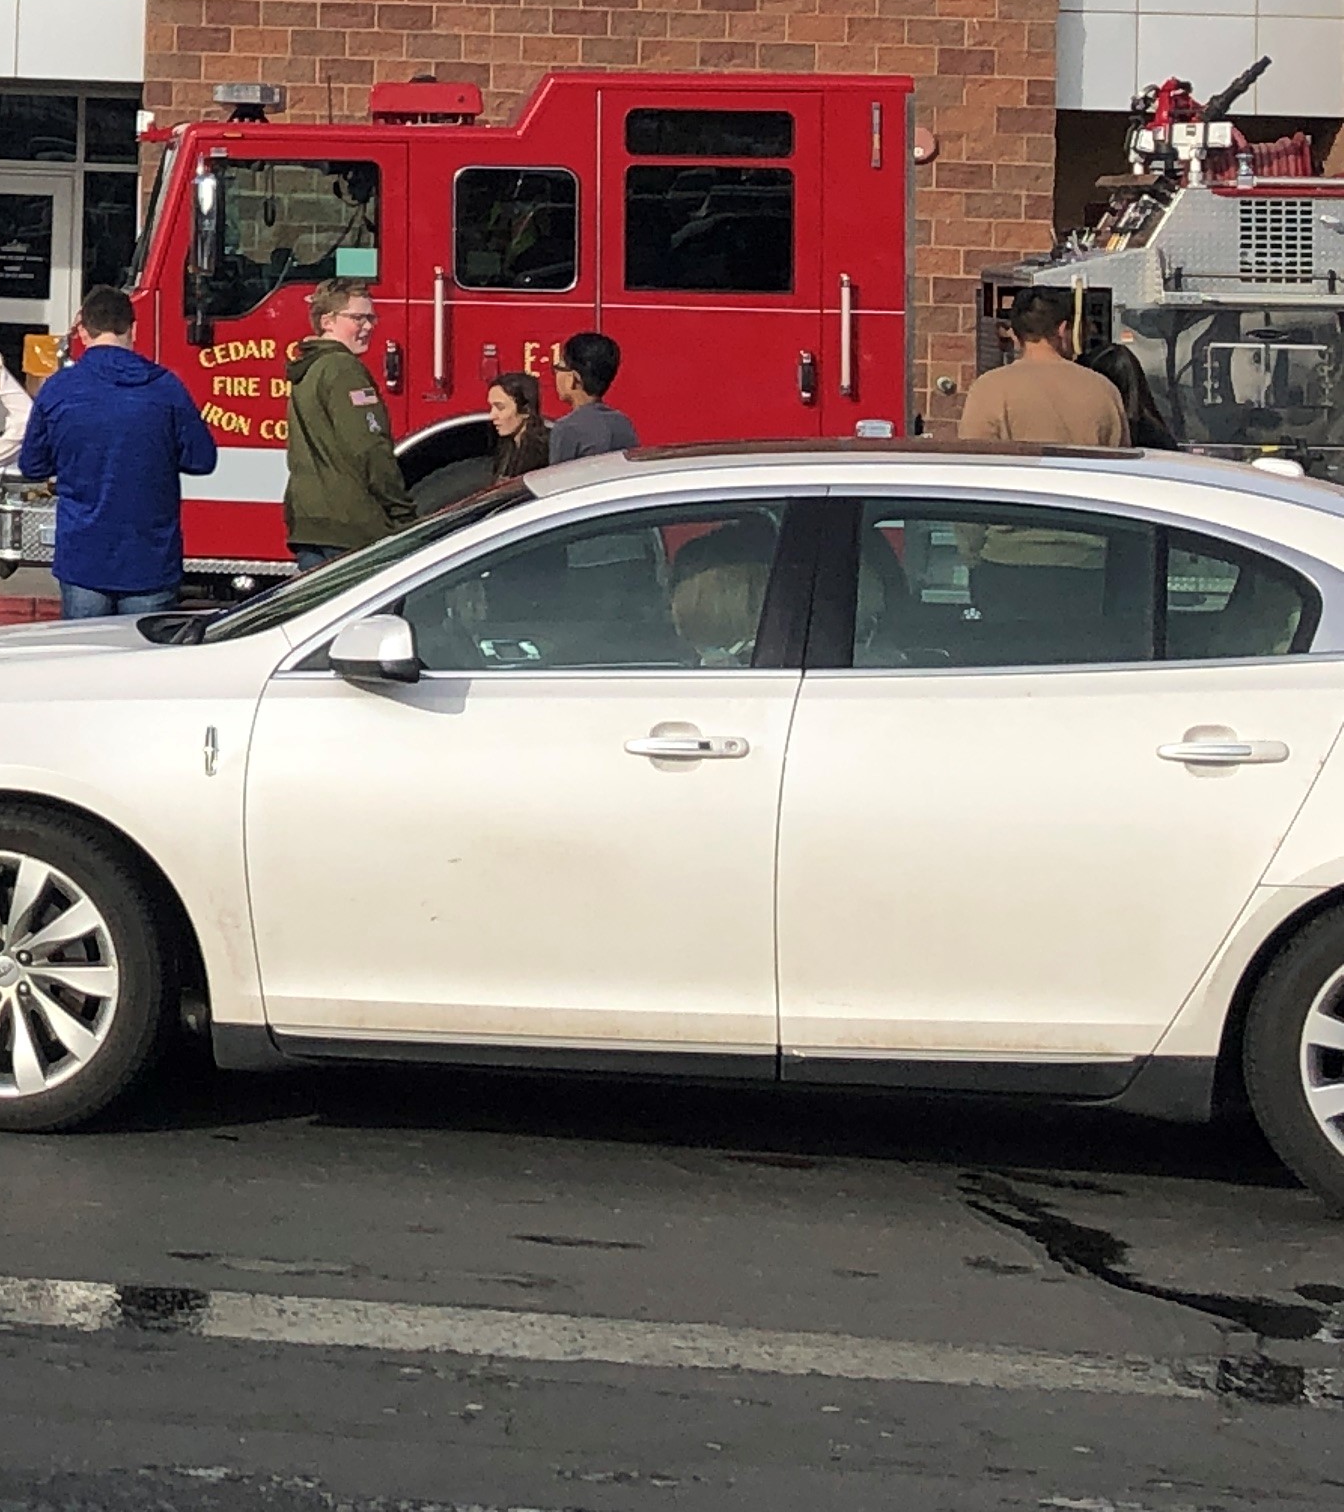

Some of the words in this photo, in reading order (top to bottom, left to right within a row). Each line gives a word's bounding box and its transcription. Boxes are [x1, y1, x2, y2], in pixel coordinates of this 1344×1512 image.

[198, 339, 276, 368] CEDAR
[212, 375, 261, 398] FIRE
[200, 401, 252, 436] IRON
